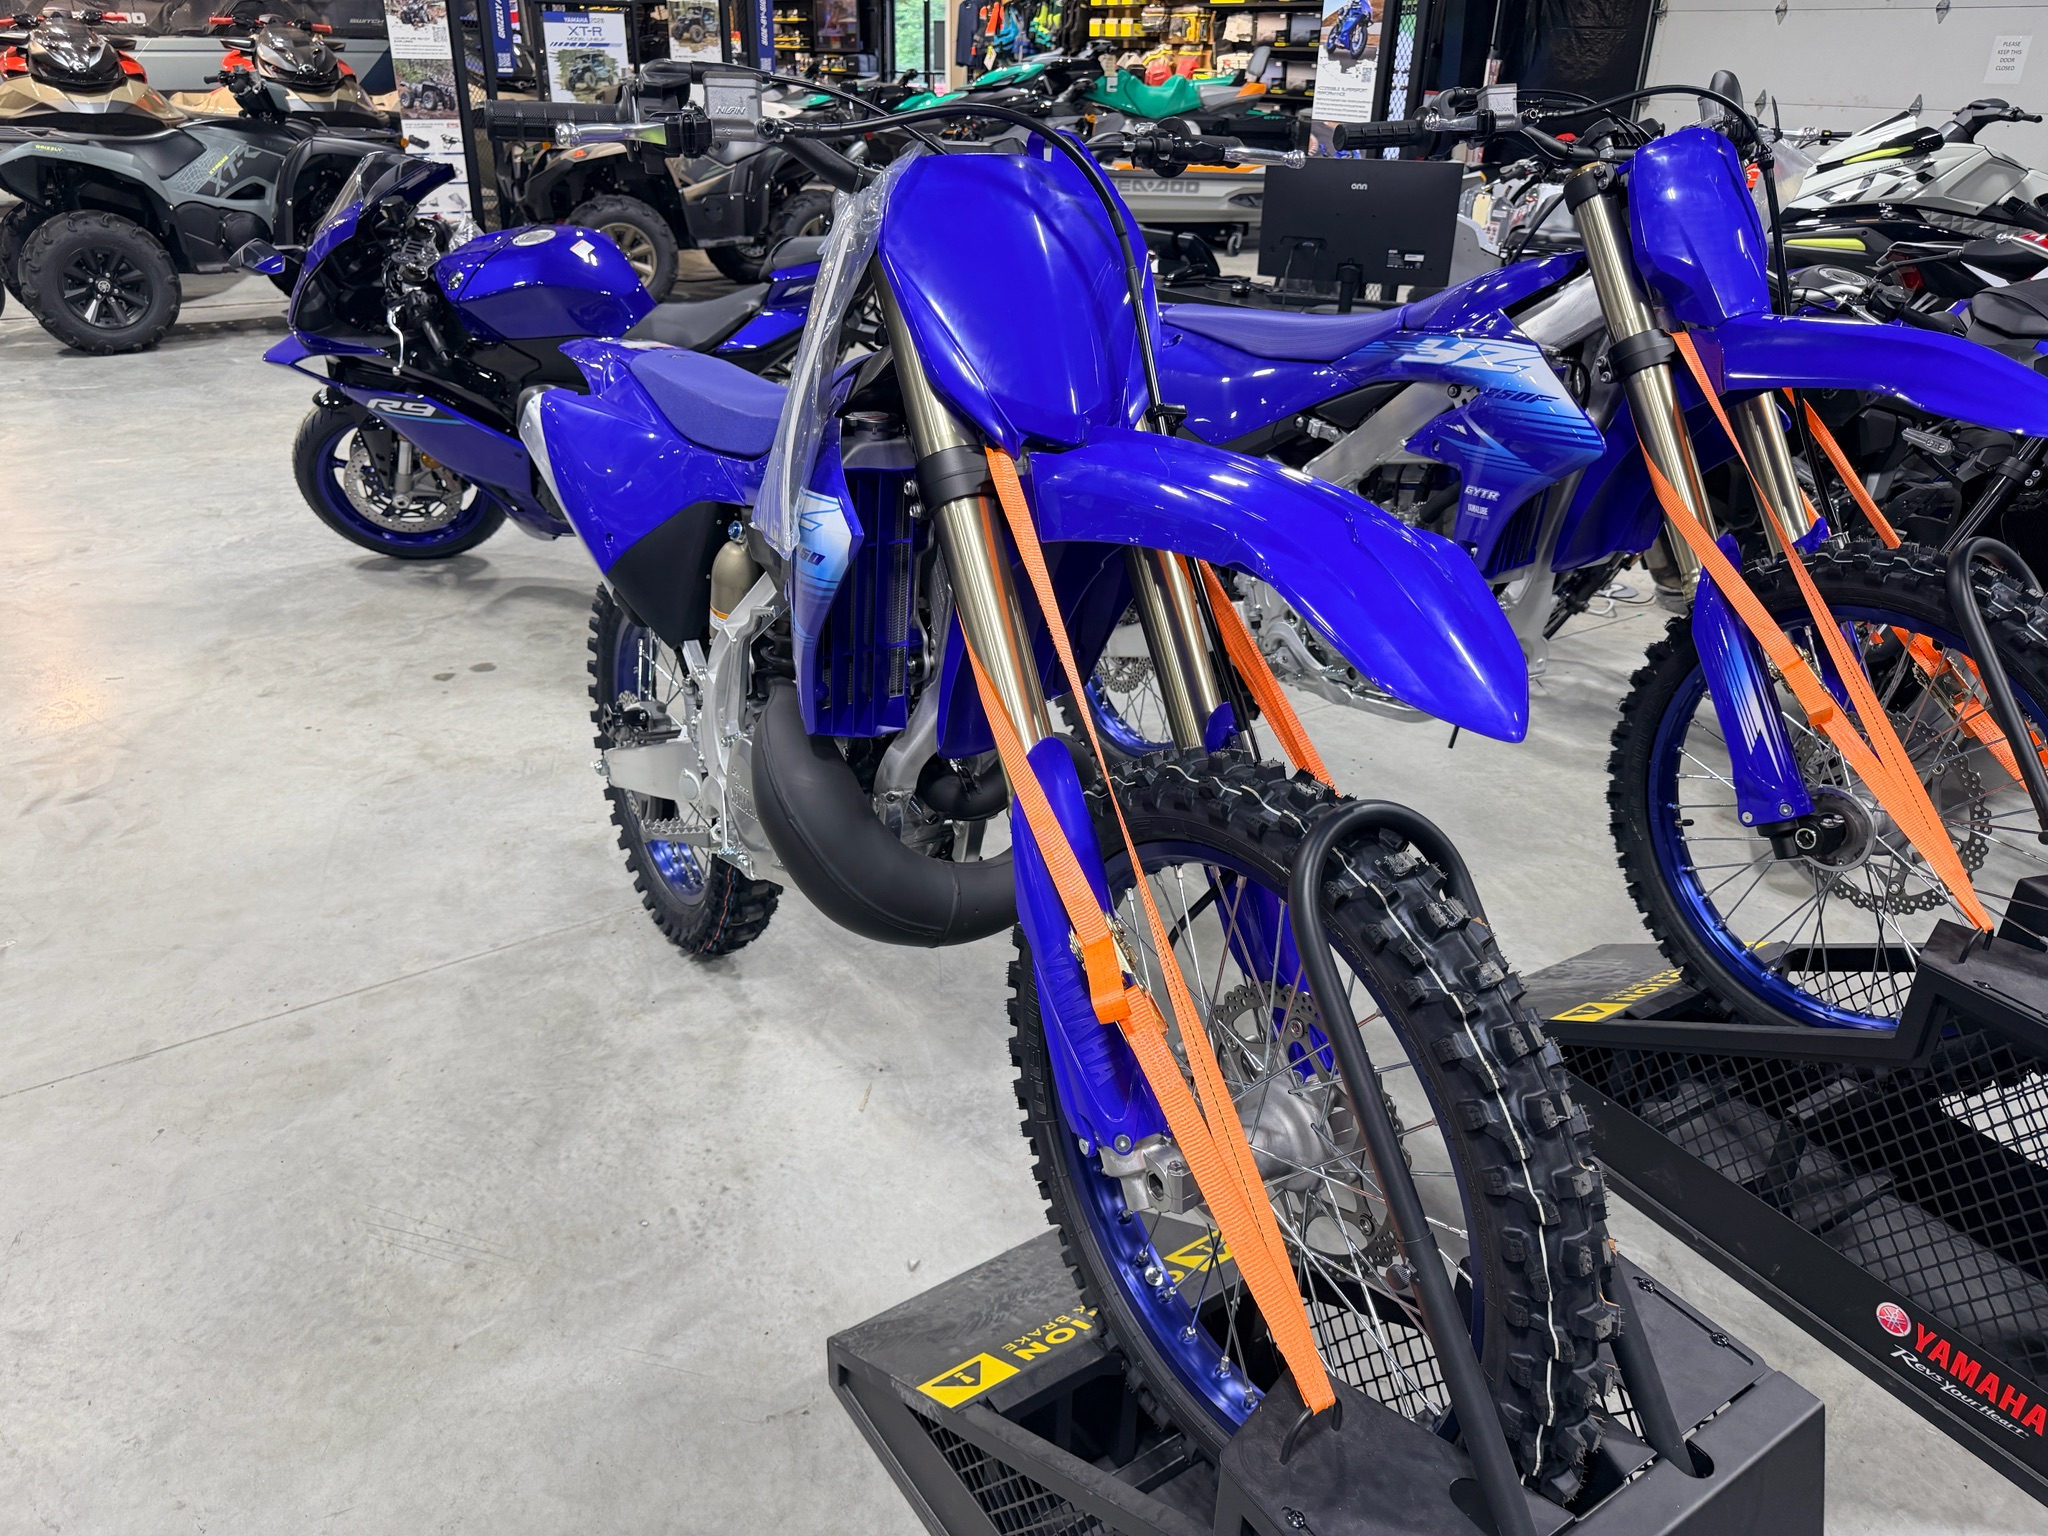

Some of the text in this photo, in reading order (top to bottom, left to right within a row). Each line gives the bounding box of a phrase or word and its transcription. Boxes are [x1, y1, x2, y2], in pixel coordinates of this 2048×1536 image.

[495, 3, 506, 39] GRIZZLY
[568, 26, 603, 37] XT-R
[759, 0, 769, 46] SIDE-BY-SID
[35, 144, 62, 152] GRIZZLY
[367, 398, 436, 417] R9
[1464, 485, 1500, 501] GYTR
[1041, 943, 1123, 1088] YAMAHA
[1001, 1315, 1071, 1352] BRAKE
[1890, 1344, 2027, 1434] Revs Your Heart
[1915, 1322, 2048, 1437] YAMAHA
